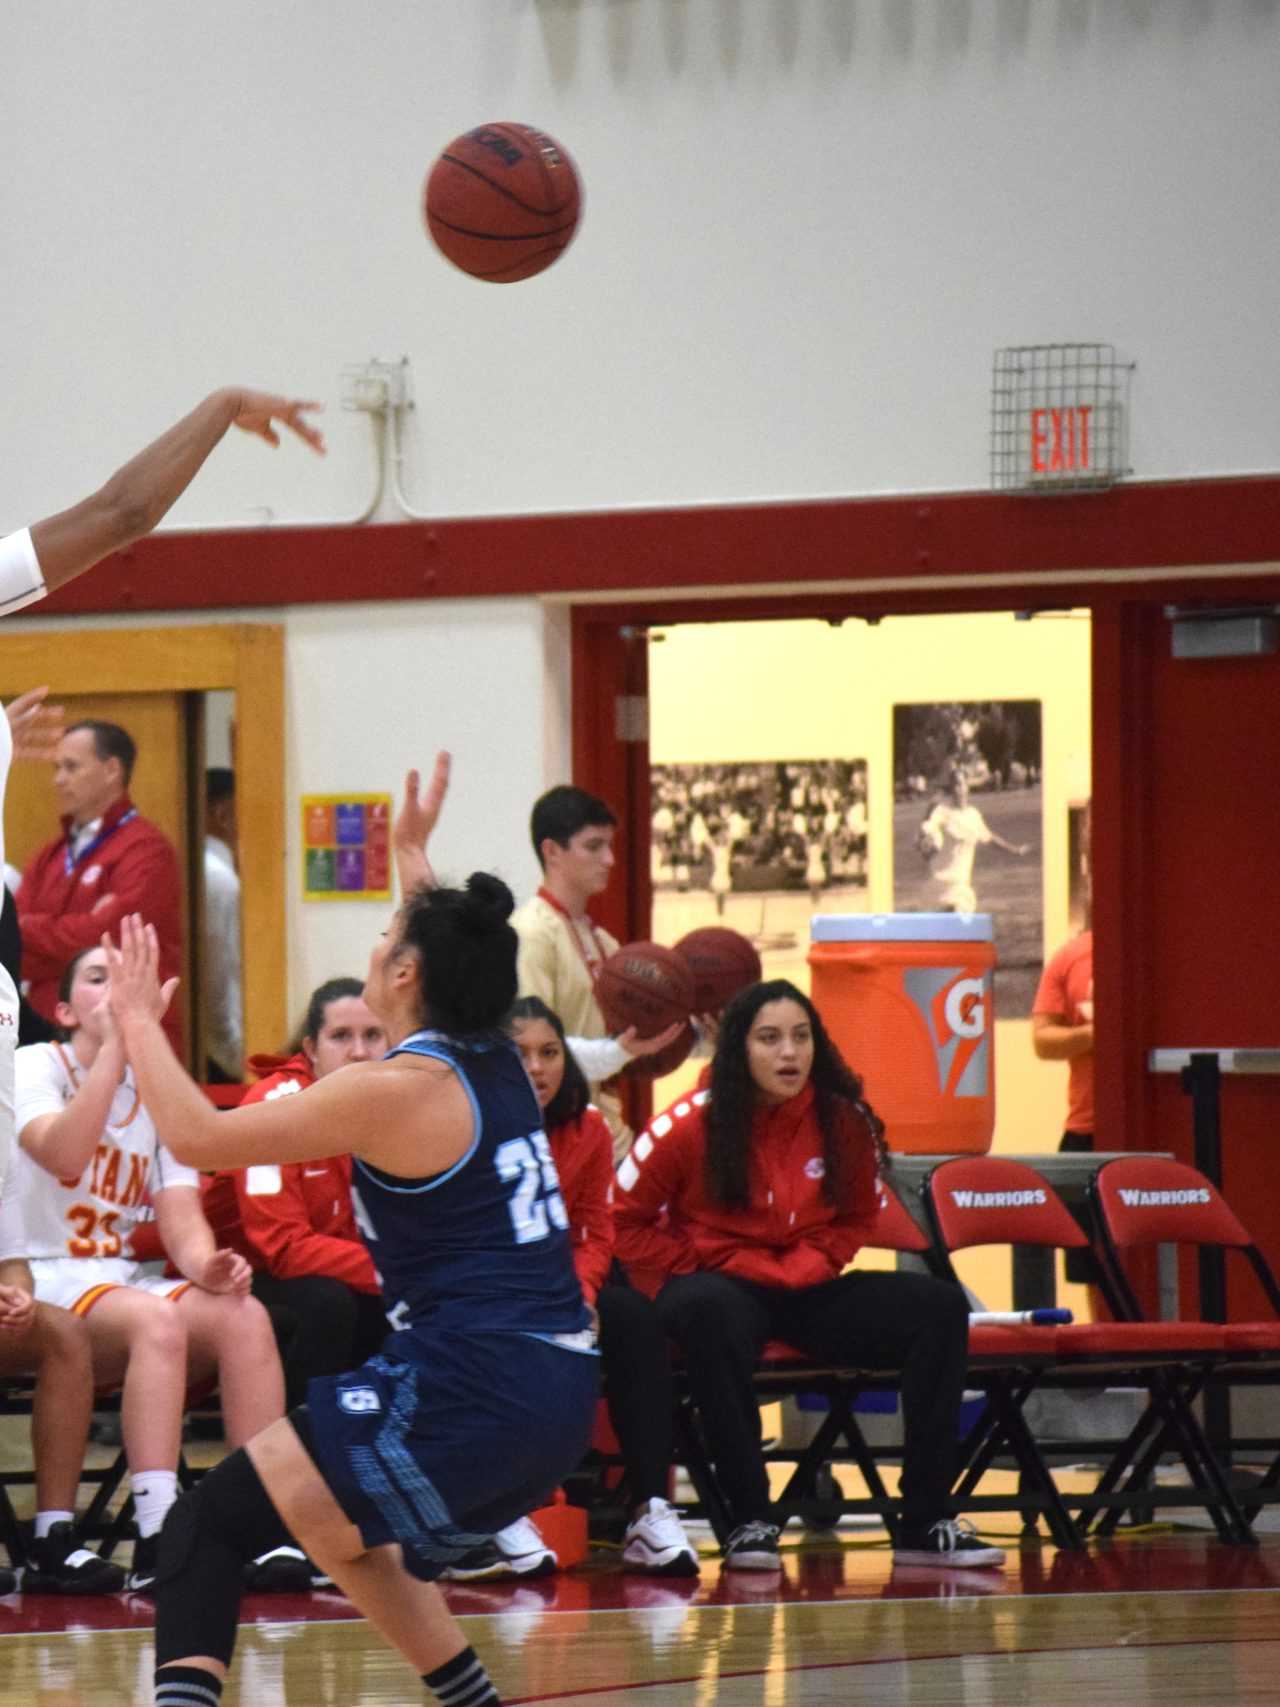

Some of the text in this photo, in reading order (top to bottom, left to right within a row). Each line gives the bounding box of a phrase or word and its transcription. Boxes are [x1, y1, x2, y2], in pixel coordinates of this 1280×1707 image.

[1031, 405, 1093, 472] EXIT
[944, 978, 985, 1038] G
[58, 1144, 149, 1208] TAN
[951, 1190, 1046, 1207] WARRIORS
[1119, 1189, 1210, 1206] WARRIORS
